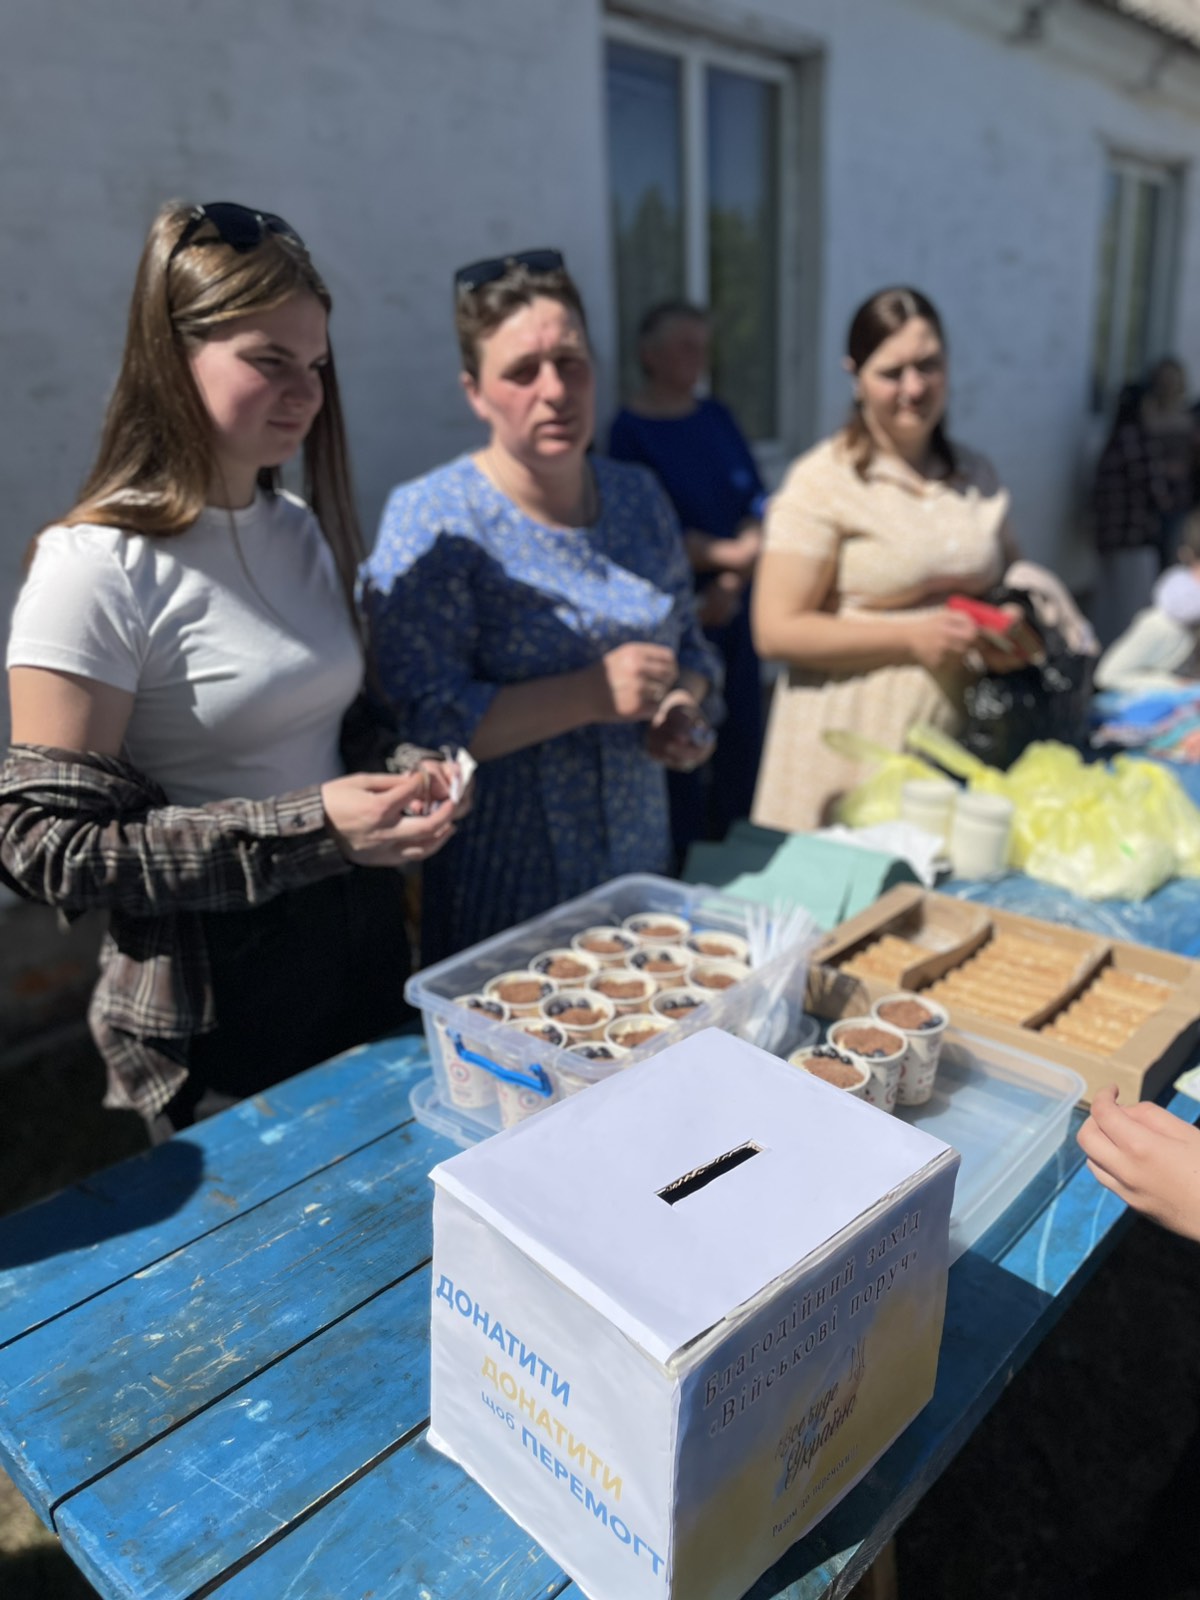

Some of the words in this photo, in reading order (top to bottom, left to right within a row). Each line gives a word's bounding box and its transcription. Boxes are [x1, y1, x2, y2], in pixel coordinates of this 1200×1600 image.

[436, 1273, 571, 1408] ДОНАТИТИ
[705, 1261, 855, 1406] Благодійний
[867, 1210, 921, 1266] захід
[710, 1308, 838, 1436] «Військові
[850, 1251, 918, 1316] поруч»
[481, 1355, 624, 1502] ДОНАТИТИ
[481, 1391, 516, 1431] щоб
[521, 1426, 668, 1584] ПЕРЕМОГТ
